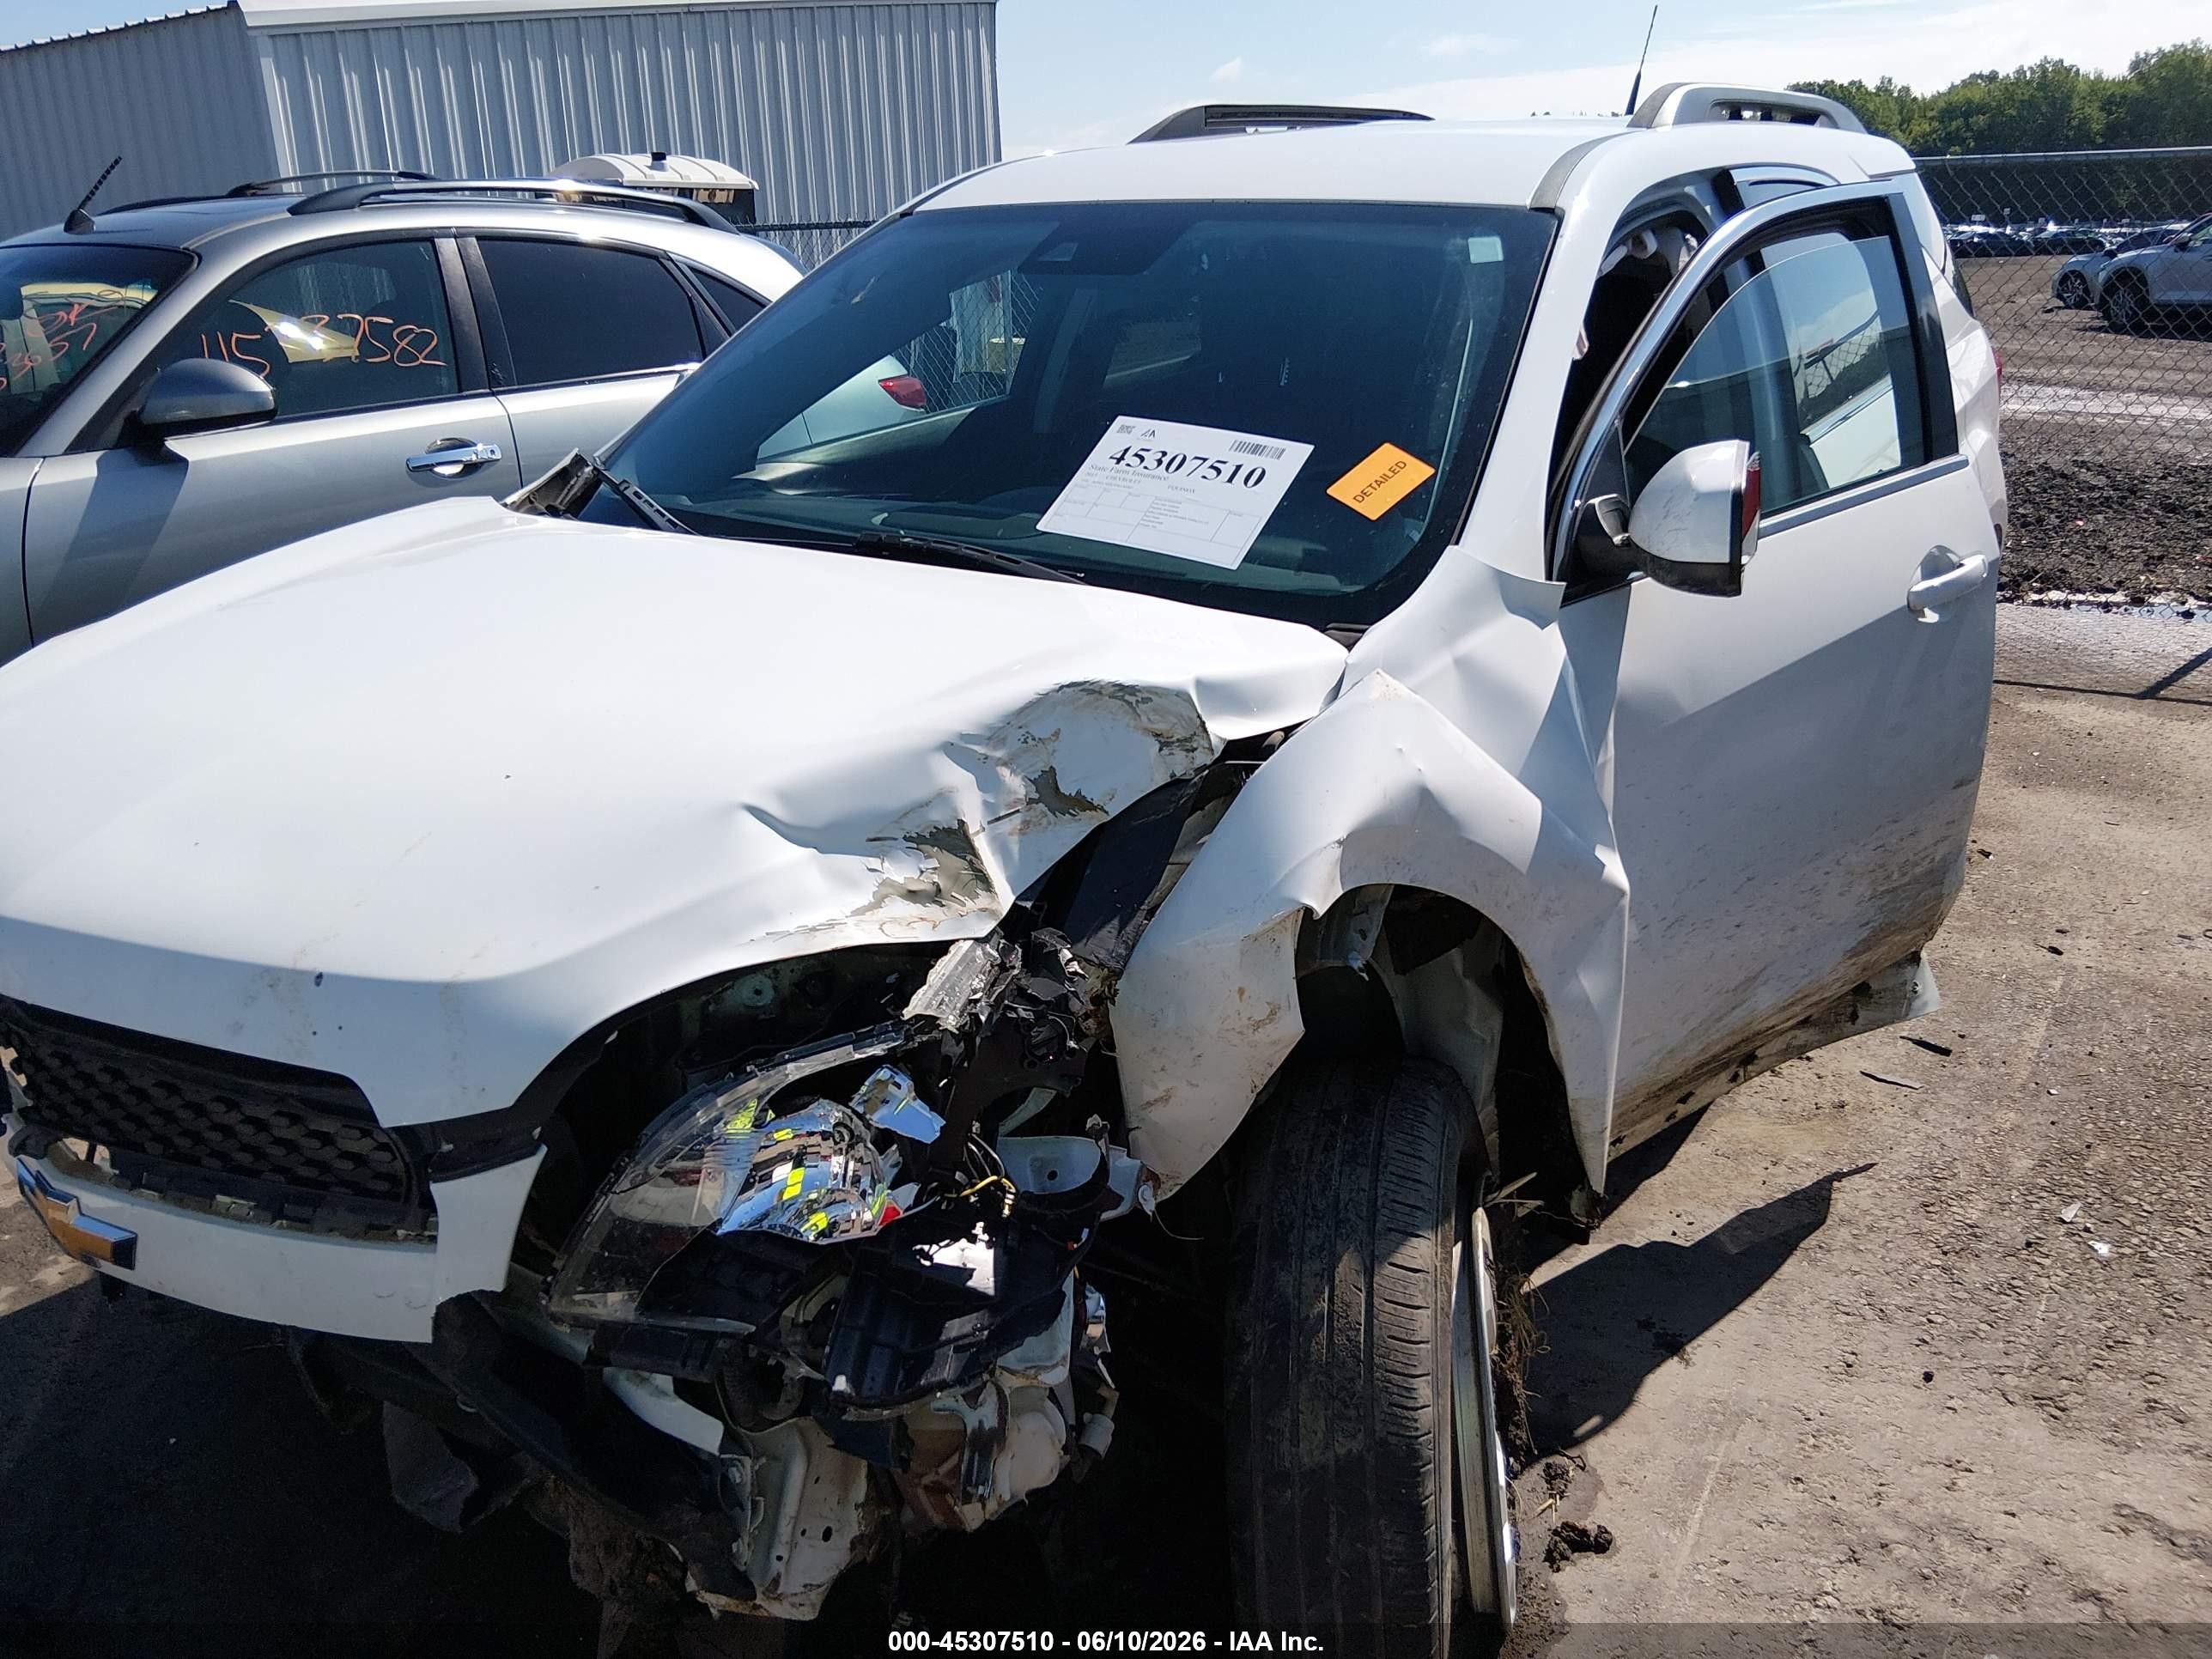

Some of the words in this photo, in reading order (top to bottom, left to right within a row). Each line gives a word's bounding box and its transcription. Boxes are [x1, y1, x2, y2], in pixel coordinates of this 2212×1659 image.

[1088, 464, 1109, 473] State
[1109, 466, 1130, 476] Farm
[1131, 470, 1170, 481] Insurance
[1108, 446, 1267, 489] 45307510
[1352, 460, 1407, 504] DETAILED
